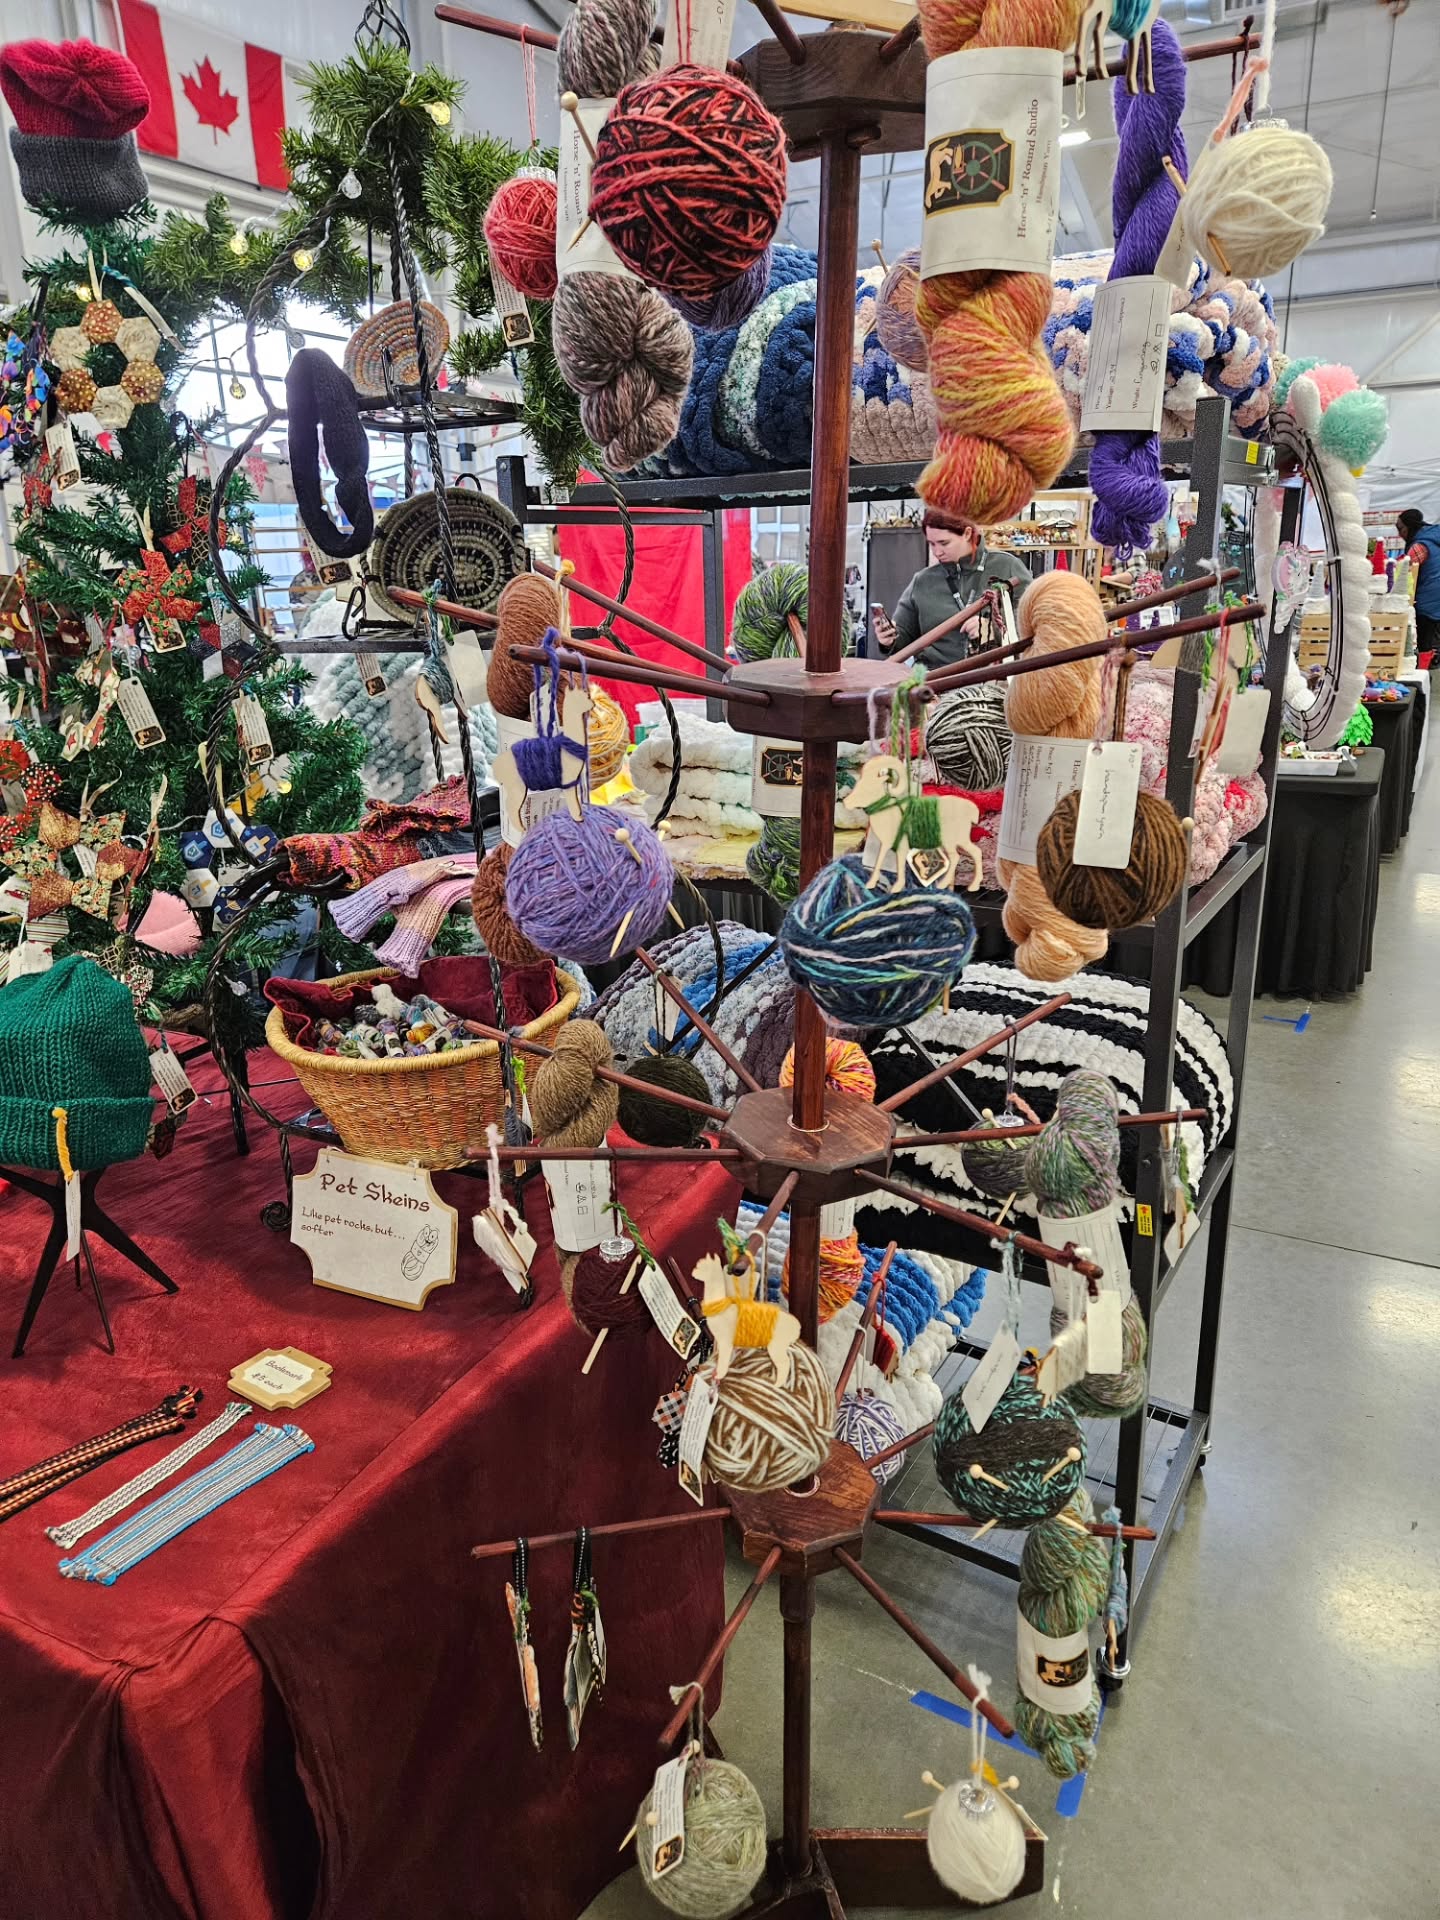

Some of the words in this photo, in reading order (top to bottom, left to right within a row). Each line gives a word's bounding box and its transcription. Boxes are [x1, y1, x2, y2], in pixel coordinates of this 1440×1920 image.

[1026, 98, 1039, 137] Studio
[1022, 140, 1037, 181] Round
[574, 180, 583, 215] Round
[1017, 202, 1028, 239] Horse
[1072, 759, 1081, 782] Horse
[1095, 817, 1106, 840] yarn
[319, 1173, 358, 1196] Pet
[363, 1181, 431, 1212] Skeins
[300, 1223, 334, 1237] softer
[302, 1206, 323, 1221] Like
[324, 1213, 342, 1225] pet
